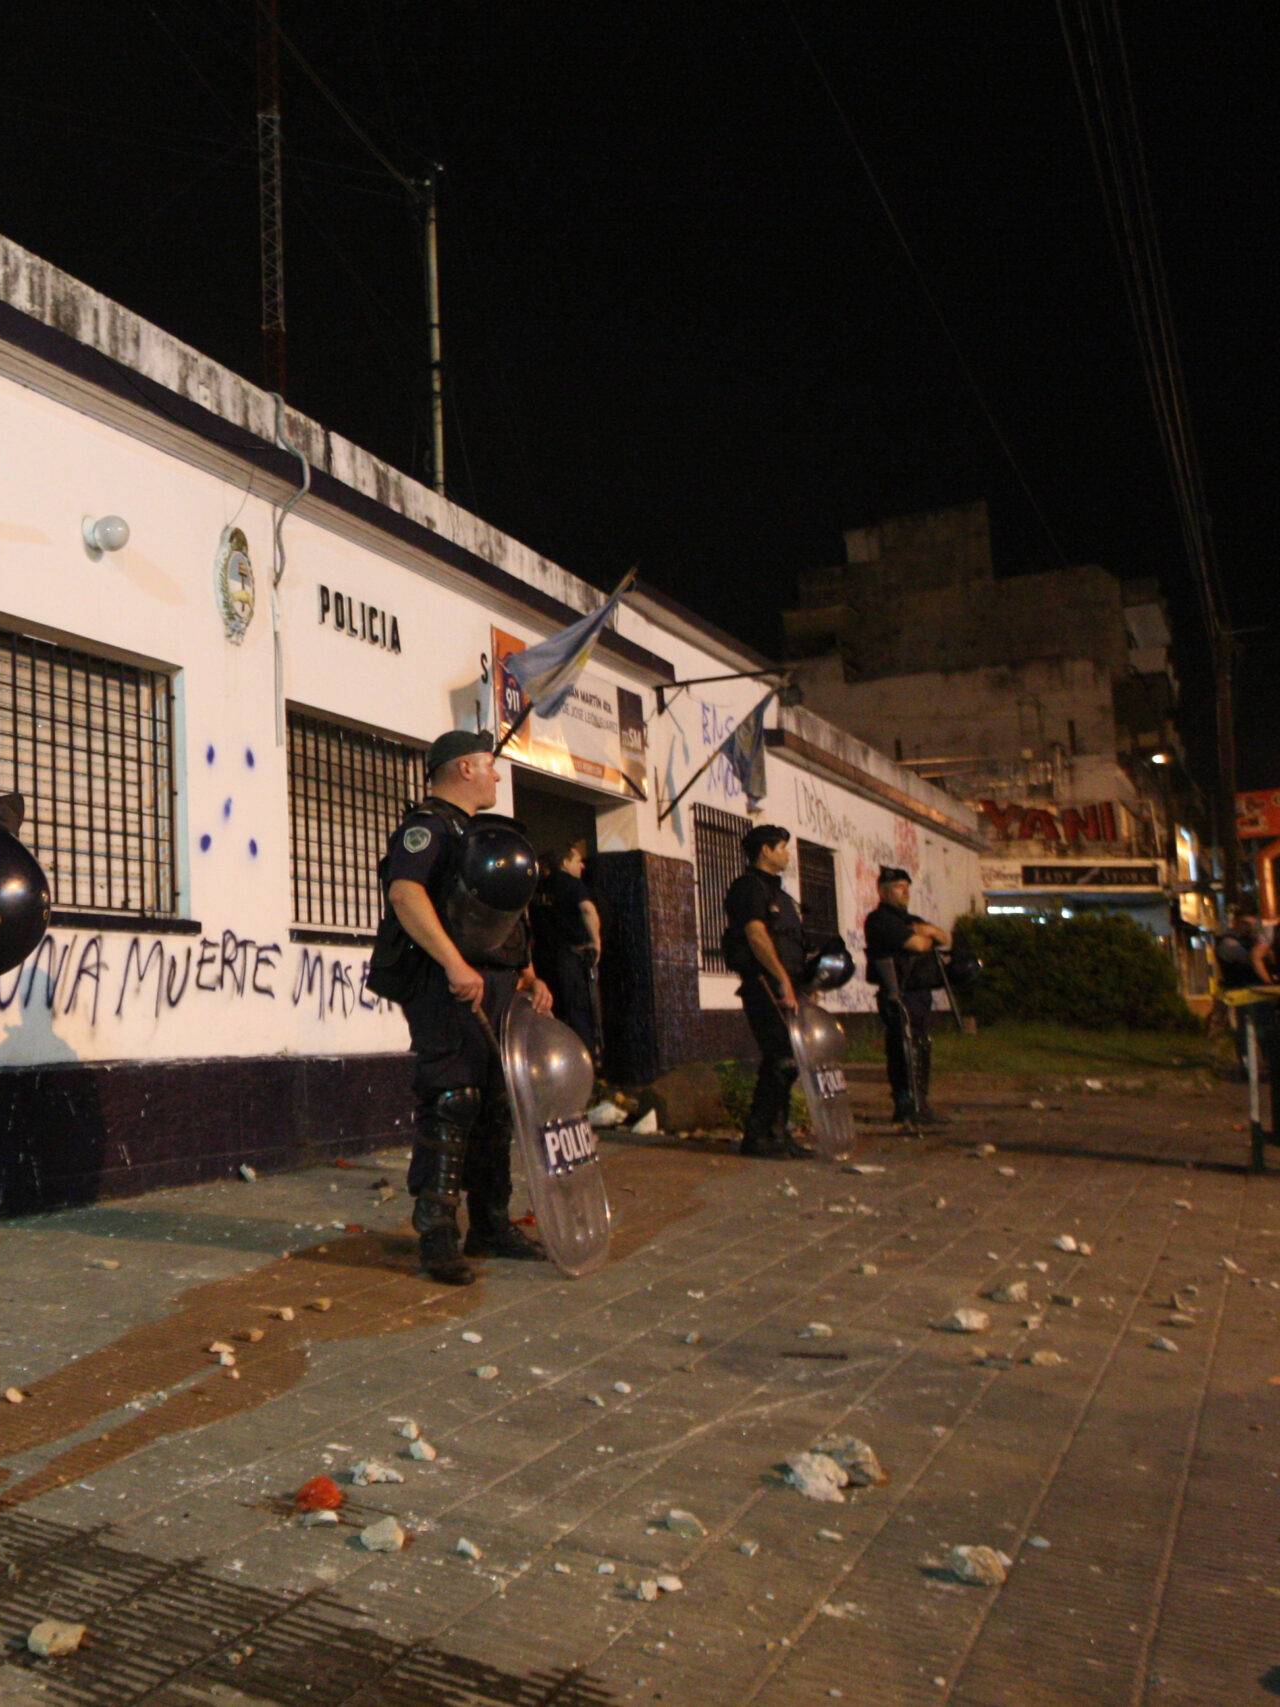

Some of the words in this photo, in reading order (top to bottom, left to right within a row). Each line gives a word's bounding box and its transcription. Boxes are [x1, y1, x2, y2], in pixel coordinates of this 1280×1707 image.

[318, 583, 402, 655] POLICIA
[505, 686, 520, 712] 911
[115, 929, 282, 1018] MUERTE
